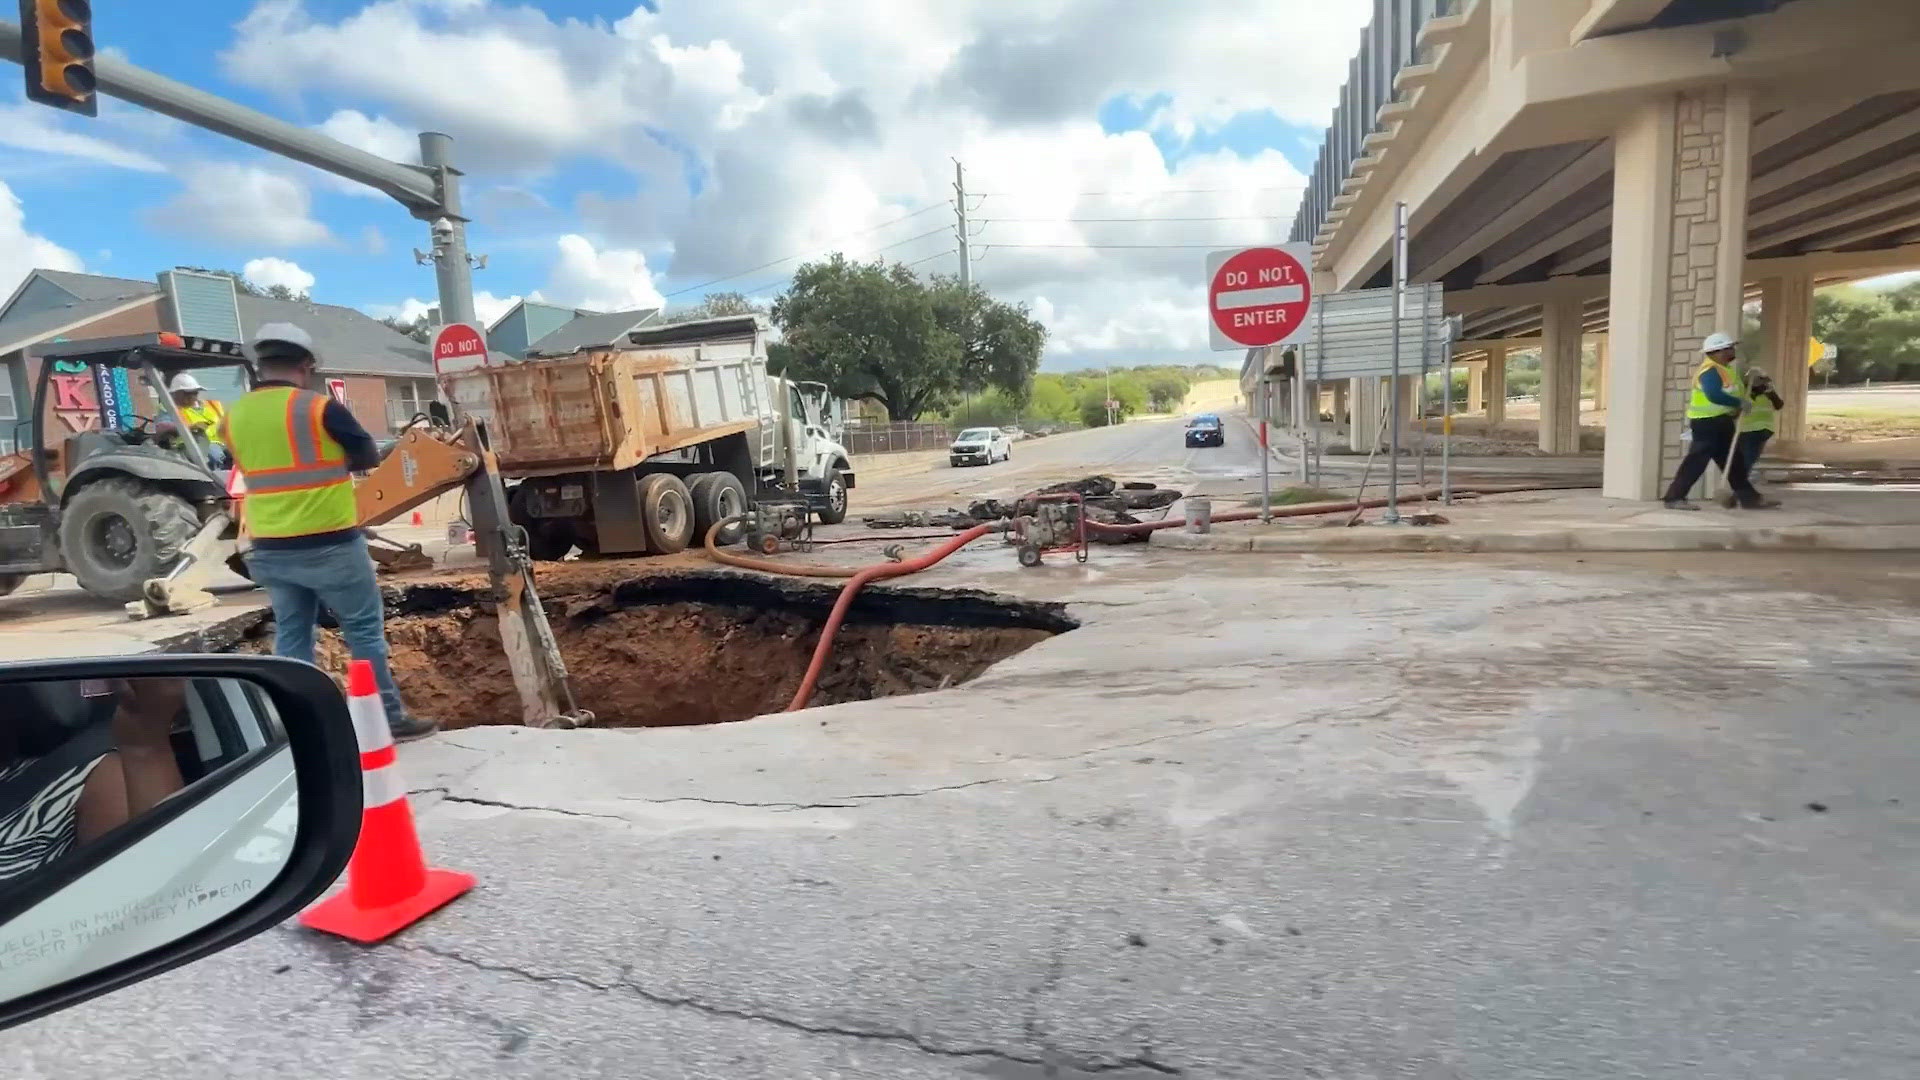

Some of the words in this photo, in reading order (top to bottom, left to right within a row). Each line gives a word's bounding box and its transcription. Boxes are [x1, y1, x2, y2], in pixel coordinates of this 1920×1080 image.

[1226, 271, 1247, 286] DO
[1259, 265, 1292, 282] NOT
[1233, 308, 1287, 328] ENTER
[440, 342, 454, 355] DO
[458, 338, 478, 353] NOT
[69, 919, 88, 935] IN
[174, 881, 204, 899] ARE
[77, 921, 126, 946] THAN
[132, 903, 177, 927] THEY
[187, 879, 252, 909] APPEAR
